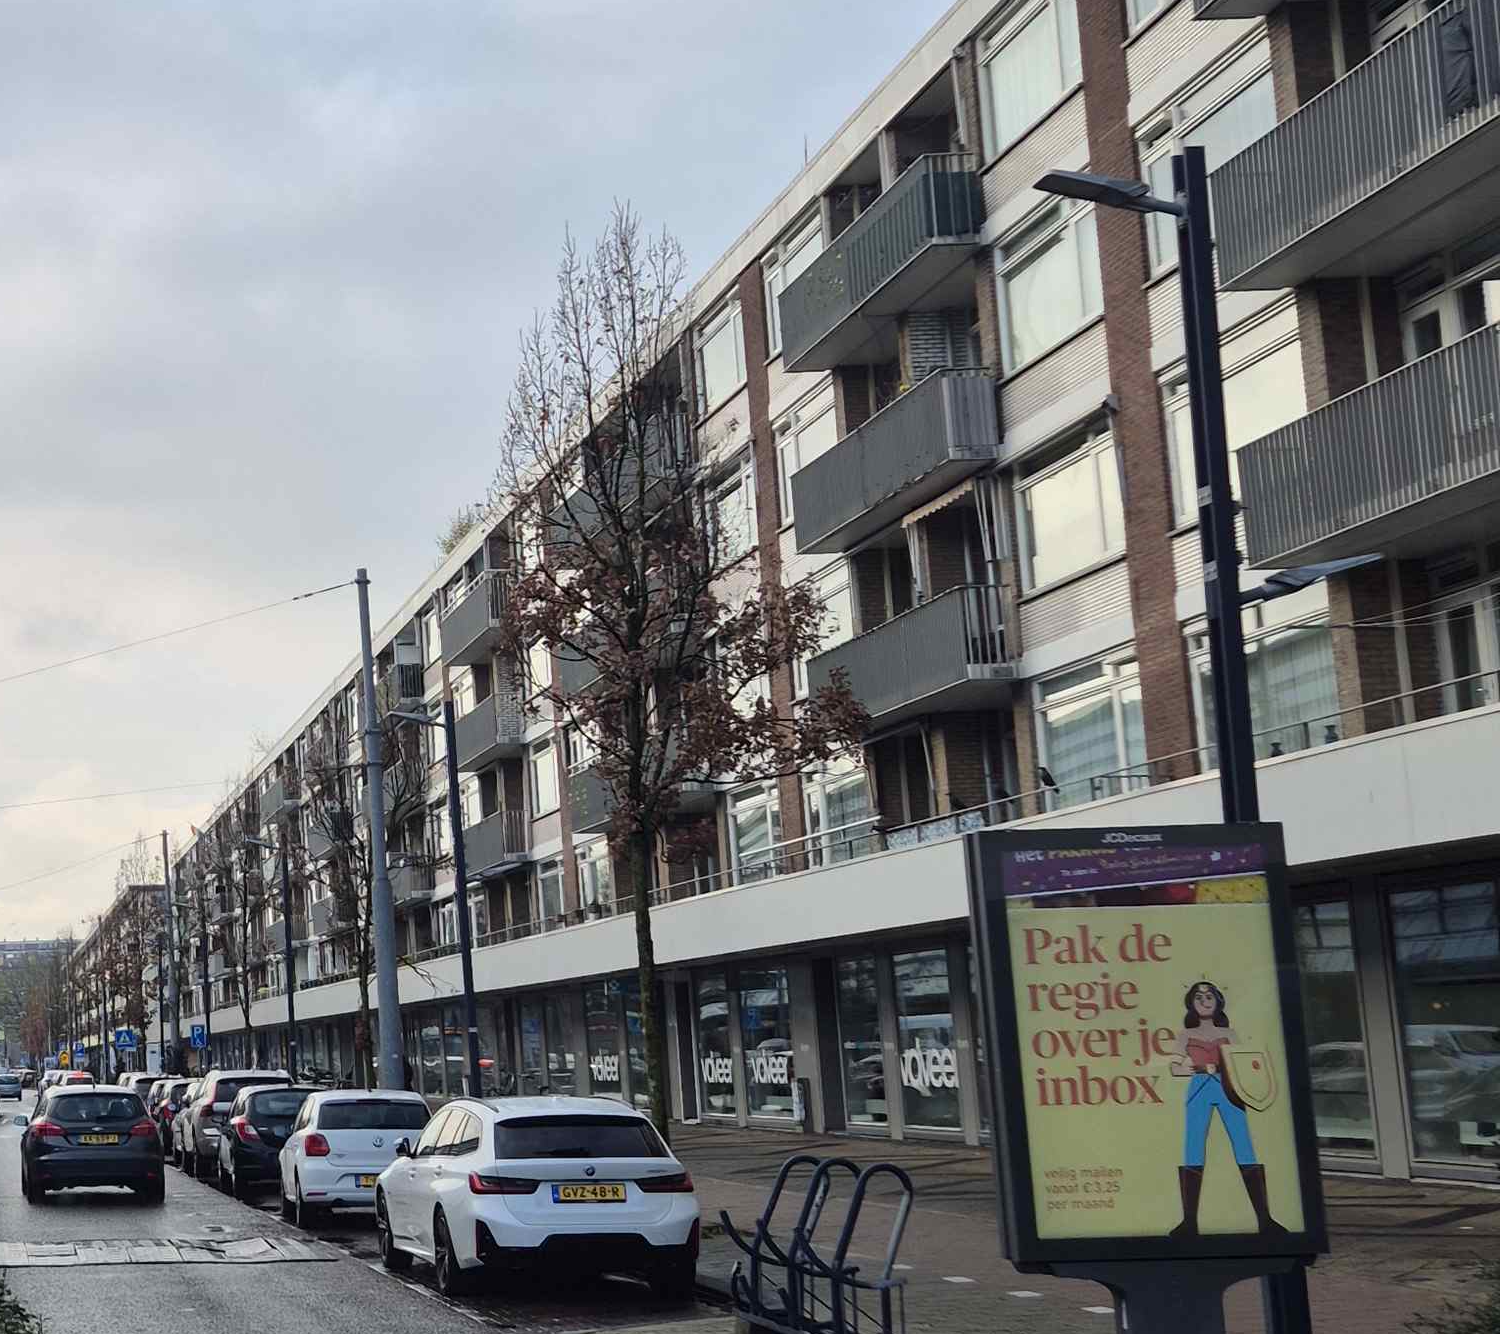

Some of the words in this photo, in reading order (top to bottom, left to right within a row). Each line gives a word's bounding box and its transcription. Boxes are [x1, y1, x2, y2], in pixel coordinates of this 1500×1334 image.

[1101, 832, 1163, 844] JCDecaux
[1022, 924, 1109, 965] Pak
[1118, 923, 1173, 963] de
[1027, 972, 1140, 1021] regie
[194, 1026, 202, 1038] P
[1031, 1027, 1129, 1059] over
[1133, 1018, 1176, 1067] je
[1036, 1066, 1165, 1107] inbox
